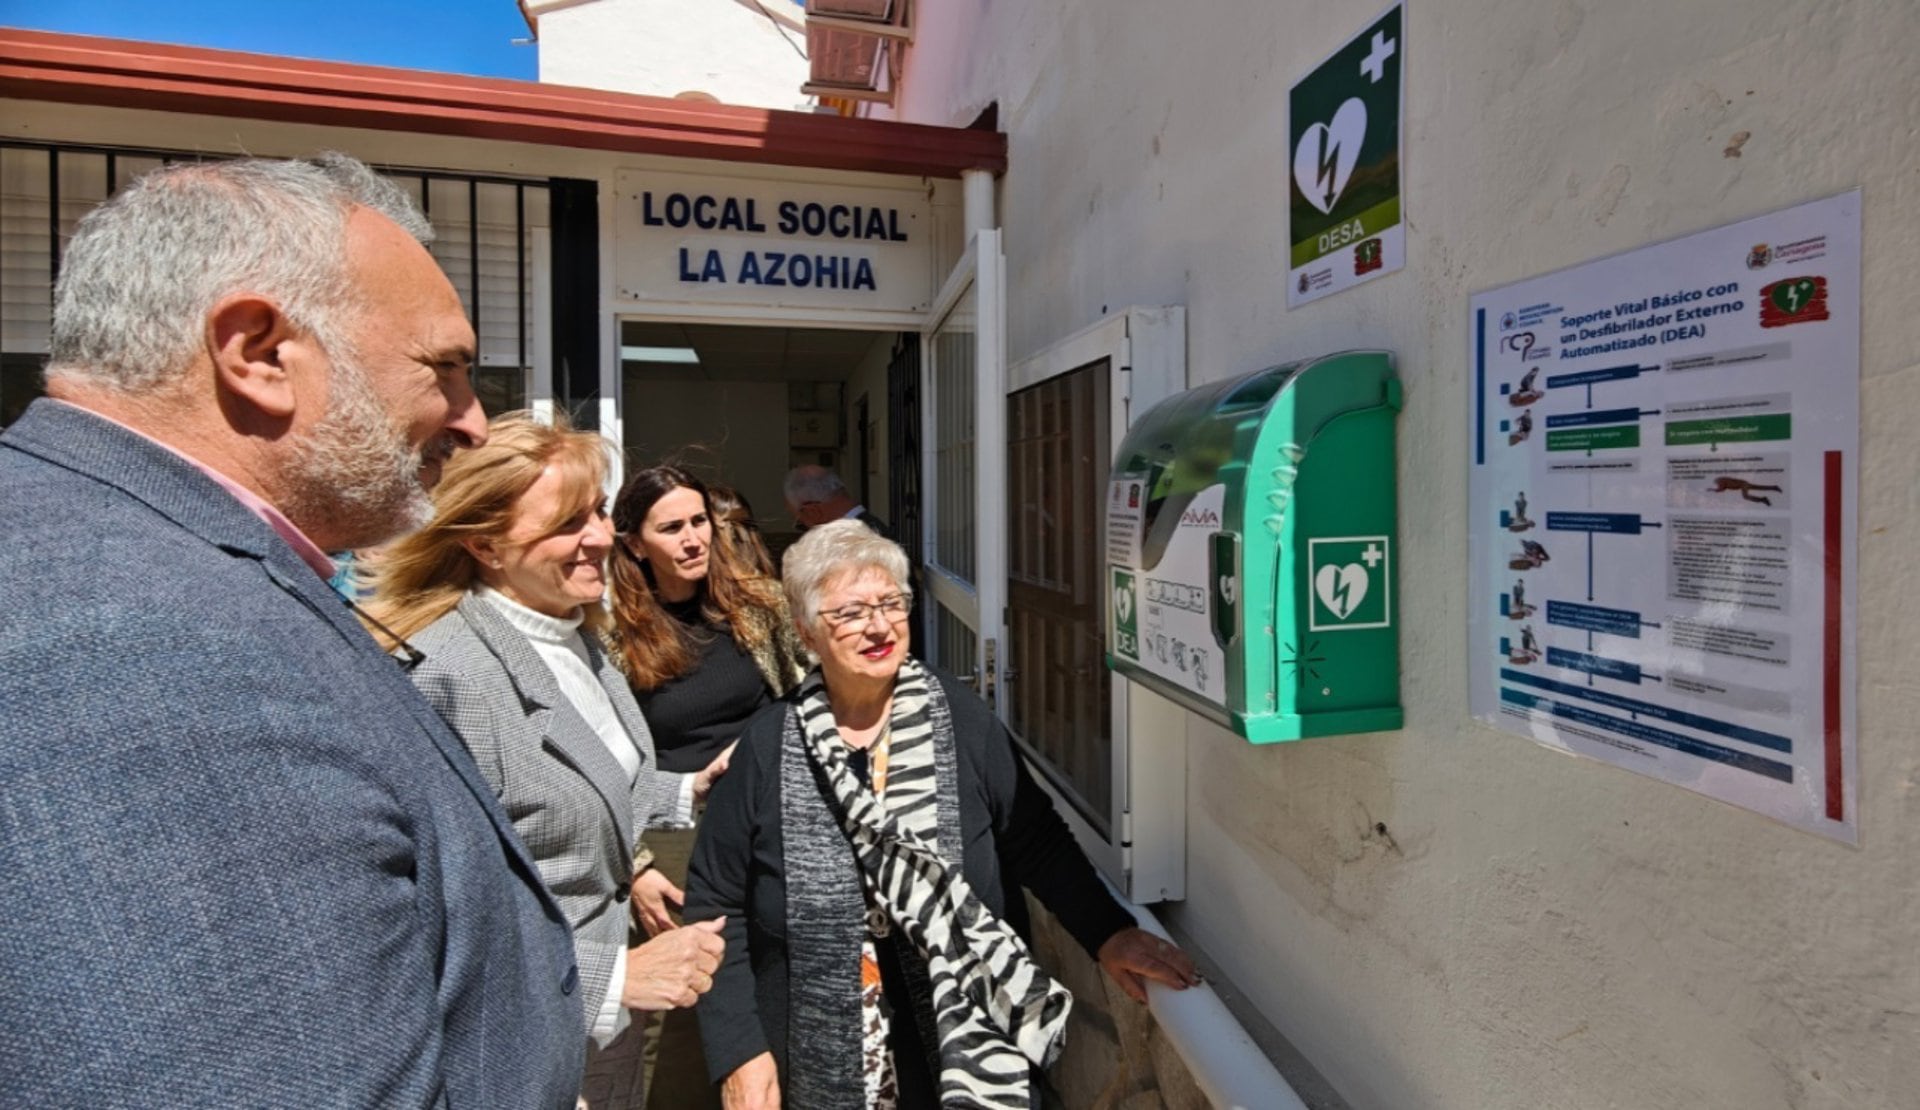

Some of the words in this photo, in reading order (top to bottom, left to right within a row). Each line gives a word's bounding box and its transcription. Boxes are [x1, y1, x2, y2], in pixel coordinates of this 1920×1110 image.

[642, 192, 766, 233] LOCAL
[778, 201, 908, 242] SOCIAL
[1318, 219, 1364, 253] DESA
[678, 247, 726, 283] LA
[737, 251, 877, 291] AZOHIA
[1560, 307, 1613, 329] Soporte
[1614, 298, 1648, 317] Vital
[1651, 290, 1703, 310] Básico
[1706, 282, 1739, 298] con
[1560, 332, 1577, 344] un
[1579, 313, 1672, 340] Desfibrilador
[1675, 300, 1744, 322] Externo
[1559, 333, 1657, 360] Automatizado
[1660, 323, 1706, 345] (DEA)
